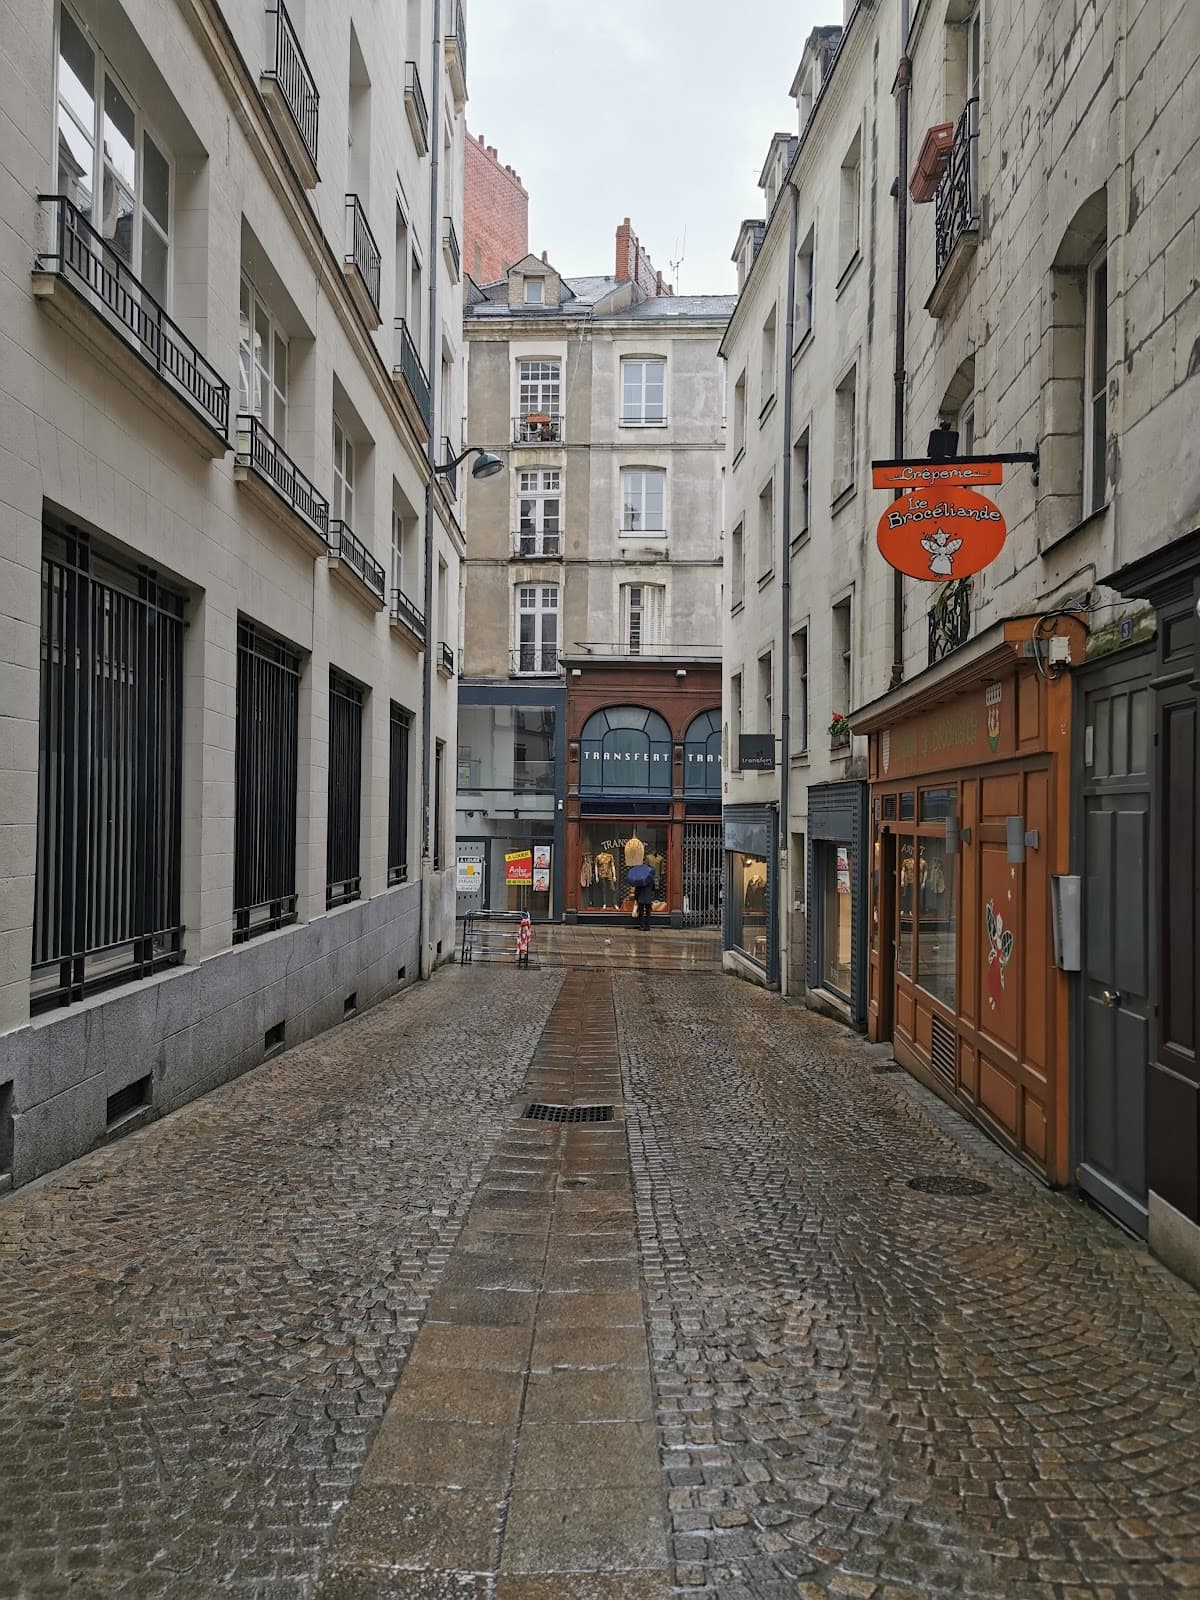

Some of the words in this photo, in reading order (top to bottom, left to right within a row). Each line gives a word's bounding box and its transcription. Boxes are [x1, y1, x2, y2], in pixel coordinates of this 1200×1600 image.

[902, 466, 973, 485] Crêperie
[907, 497, 929, 510] Le
[888, 501, 1001, 529] Brocéliande
[584, 751, 669, 762] TRANSFERT
